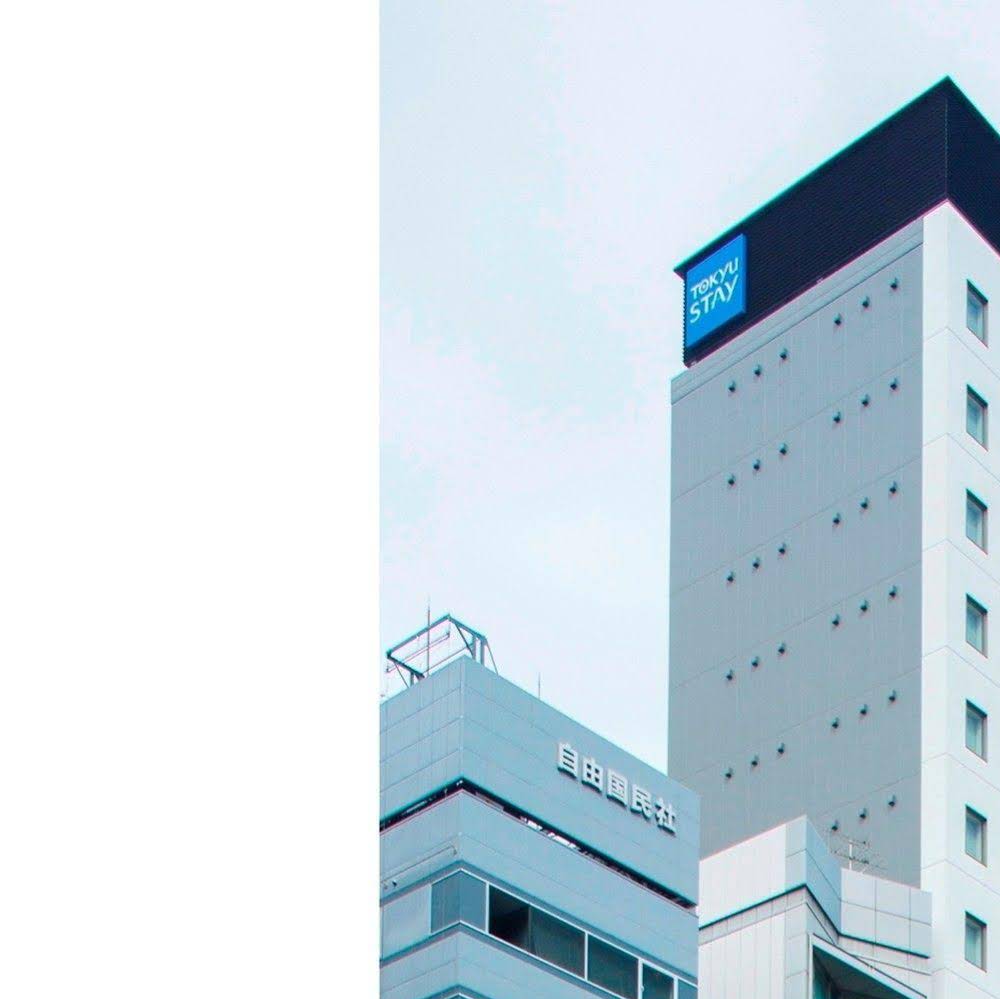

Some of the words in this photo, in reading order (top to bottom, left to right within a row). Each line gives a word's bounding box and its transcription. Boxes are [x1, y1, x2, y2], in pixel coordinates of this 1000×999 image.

[689, 274, 739, 324] STAY
[690, 257, 739, 299] TOKYU
[557, 742, 677, 835] 自由国民社
